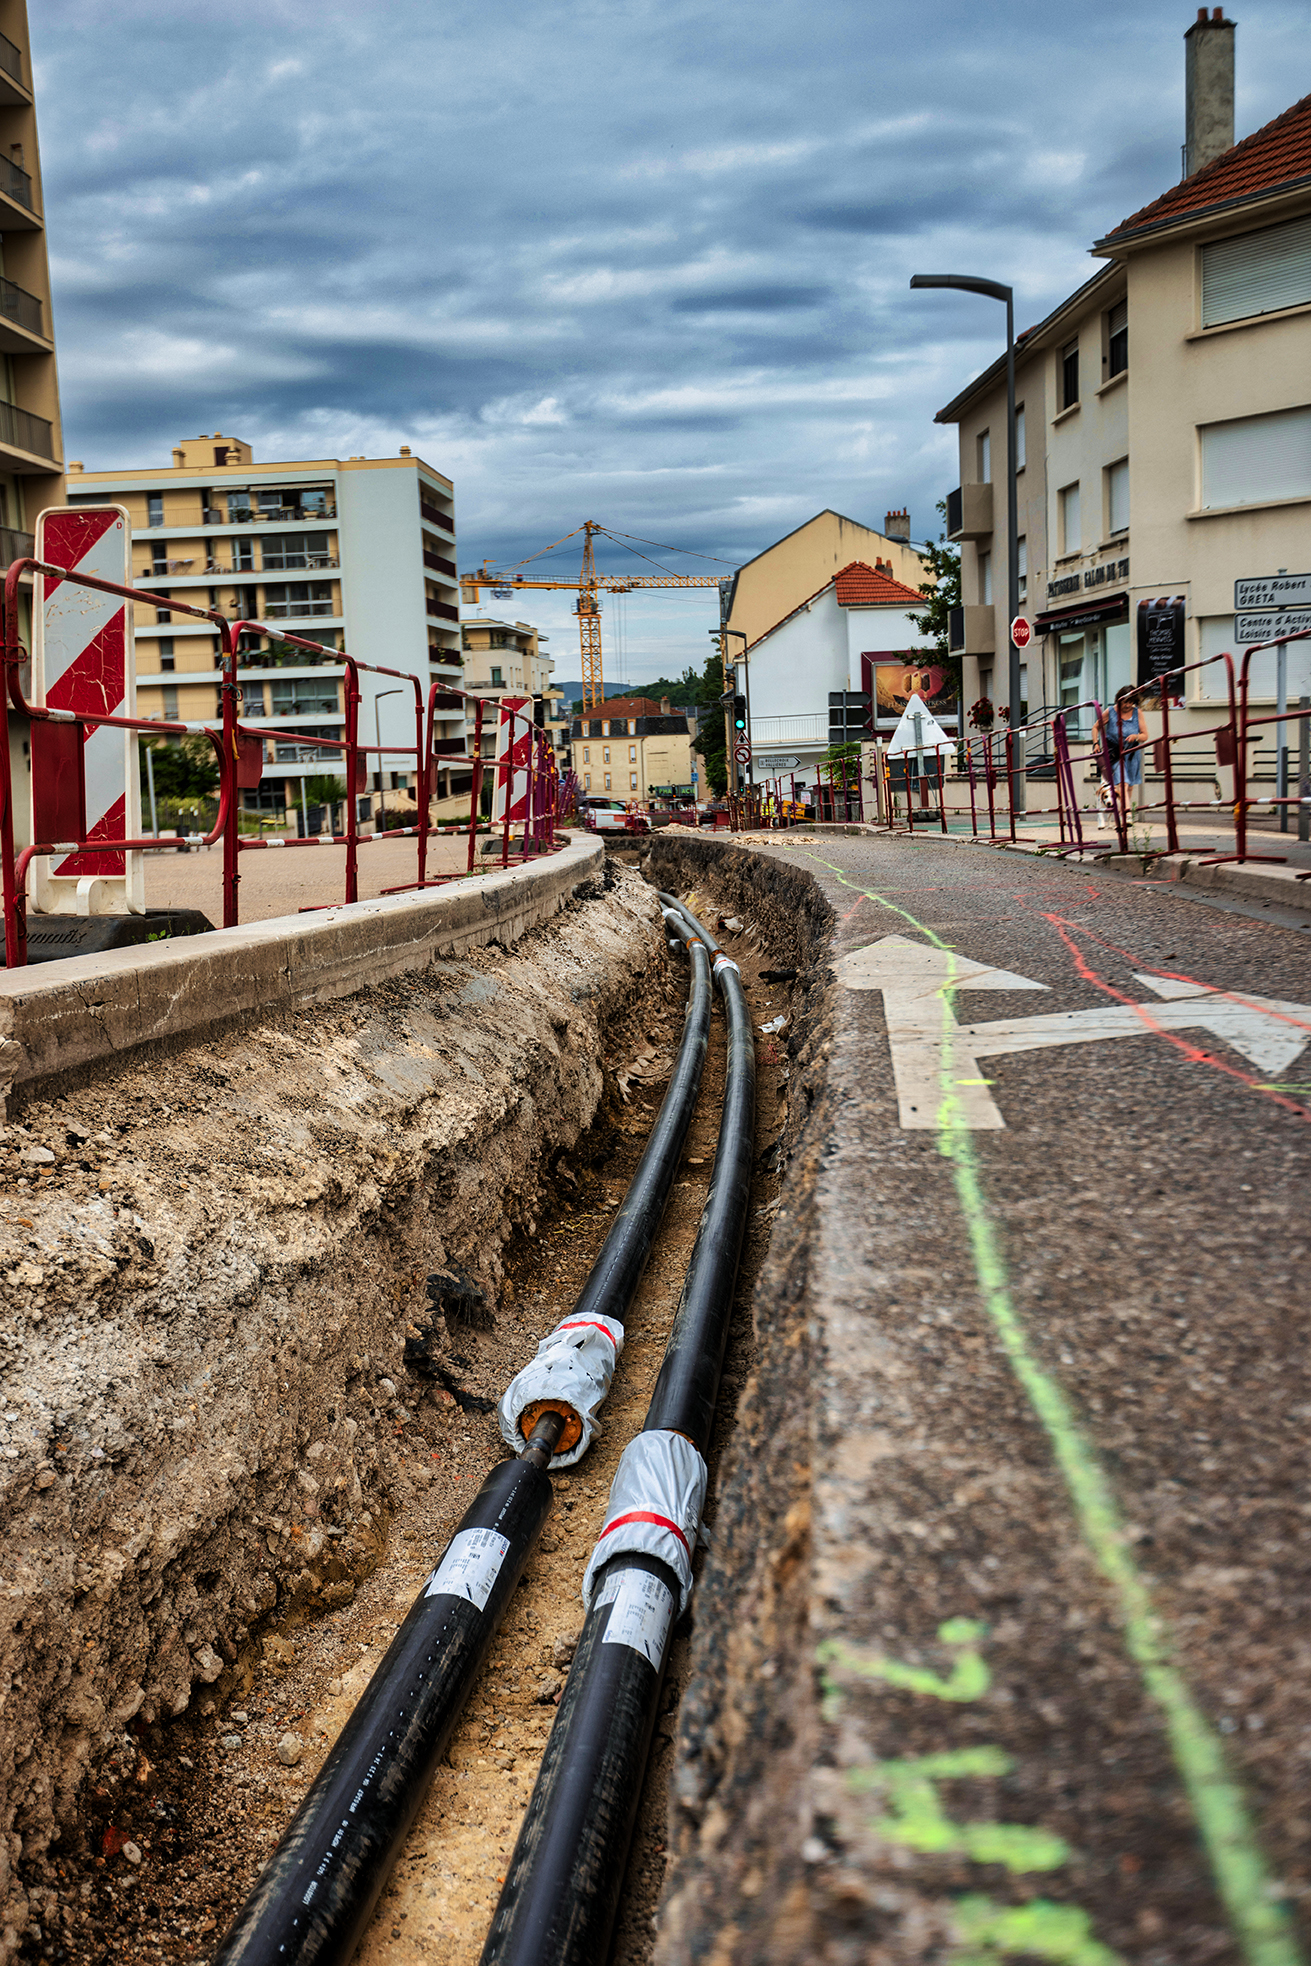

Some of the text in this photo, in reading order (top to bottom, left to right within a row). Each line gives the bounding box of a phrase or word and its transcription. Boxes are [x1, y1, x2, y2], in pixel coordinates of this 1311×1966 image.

[116, 521, 123, 530] D
[1084, 566, 1106, 588] SALON
[1107, 562, 1116, 582] DE
[1239, 580, 1306, 595] Lycée Robert
[1240, 593, 1275, 605] GRETA
[1240, 614, 1311, 628] Centre d'Activ
[1013, 627, 1030, 638] STOP
[1240, 627, 1272, 640] Loisirs
[1275, 627, 1287, 637] de
[302, 1880, 318, 1905] LOGSTOR
